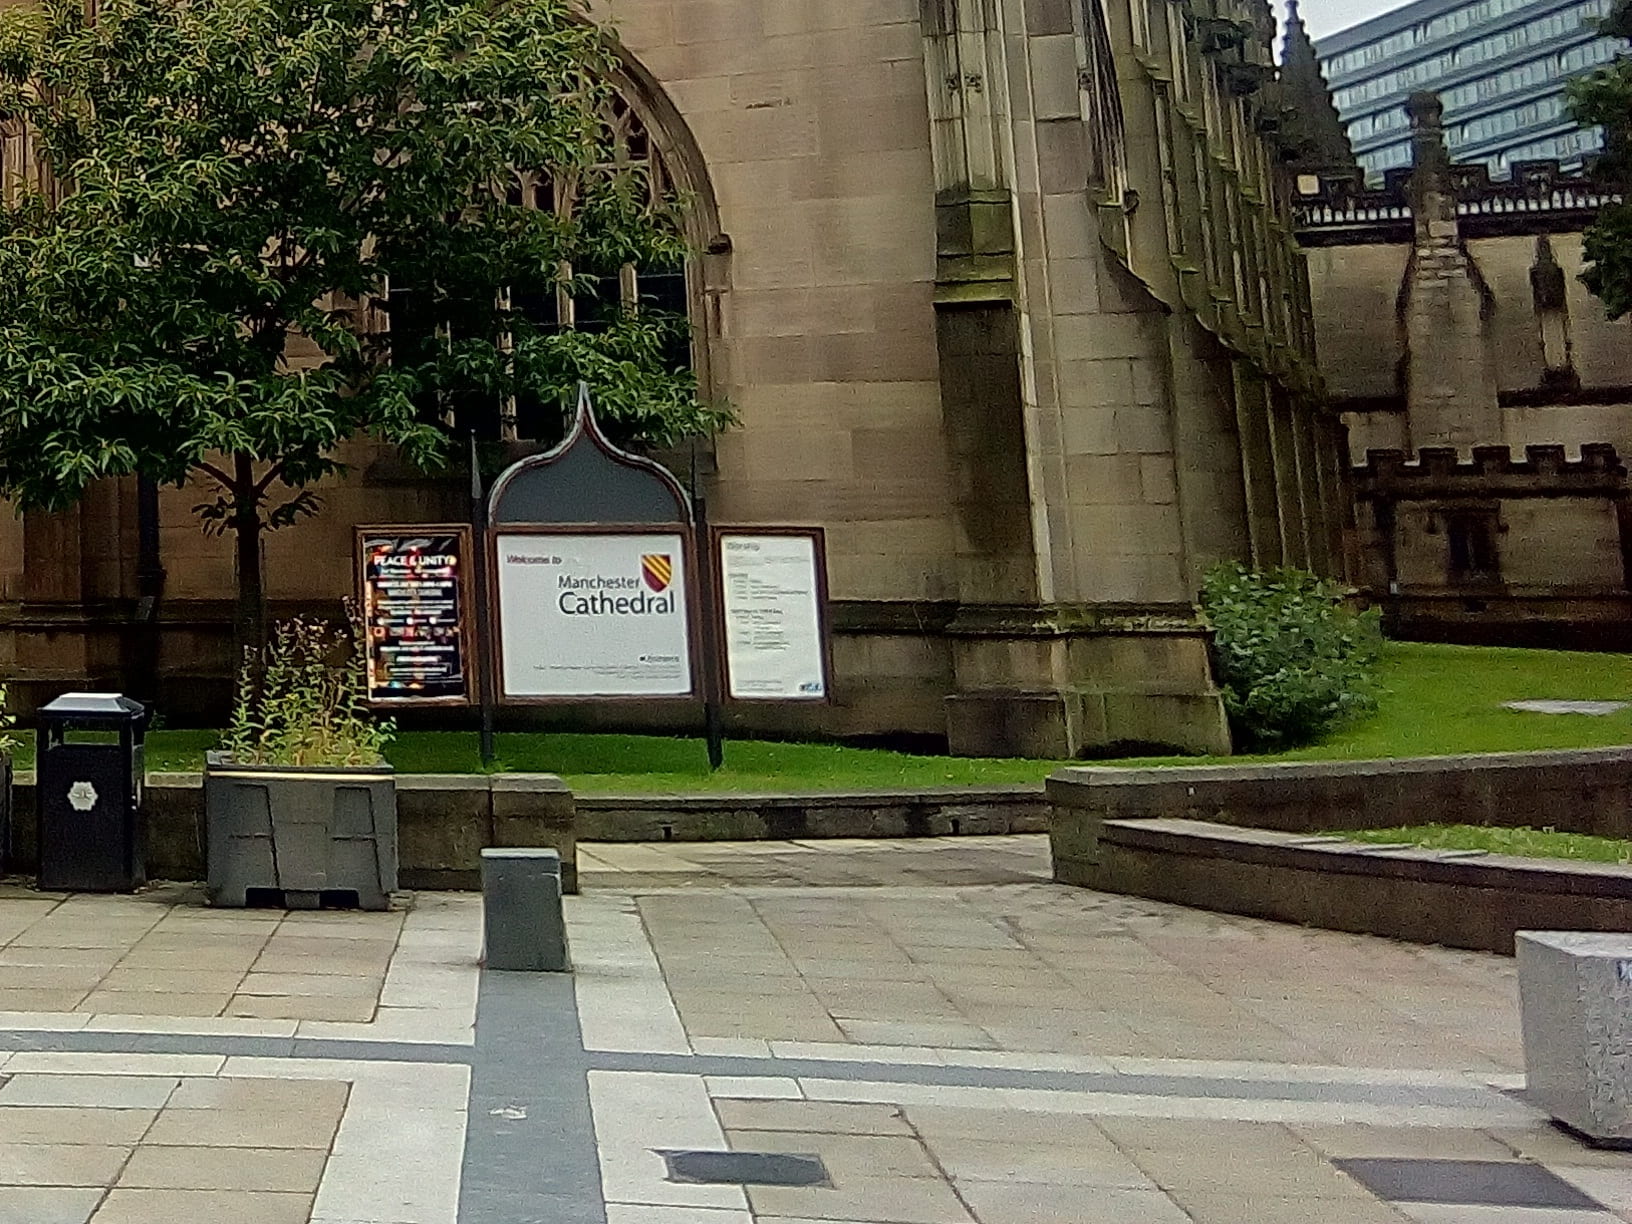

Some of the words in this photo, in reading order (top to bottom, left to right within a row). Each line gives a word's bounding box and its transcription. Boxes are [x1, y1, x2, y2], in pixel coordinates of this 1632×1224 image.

[374, 555, 408, 566] PEACE
[419, 555, 450, 565] UNITY
[558, 575, 640, 590] Manchester
[558, 590, 675, 615] Cathedral
